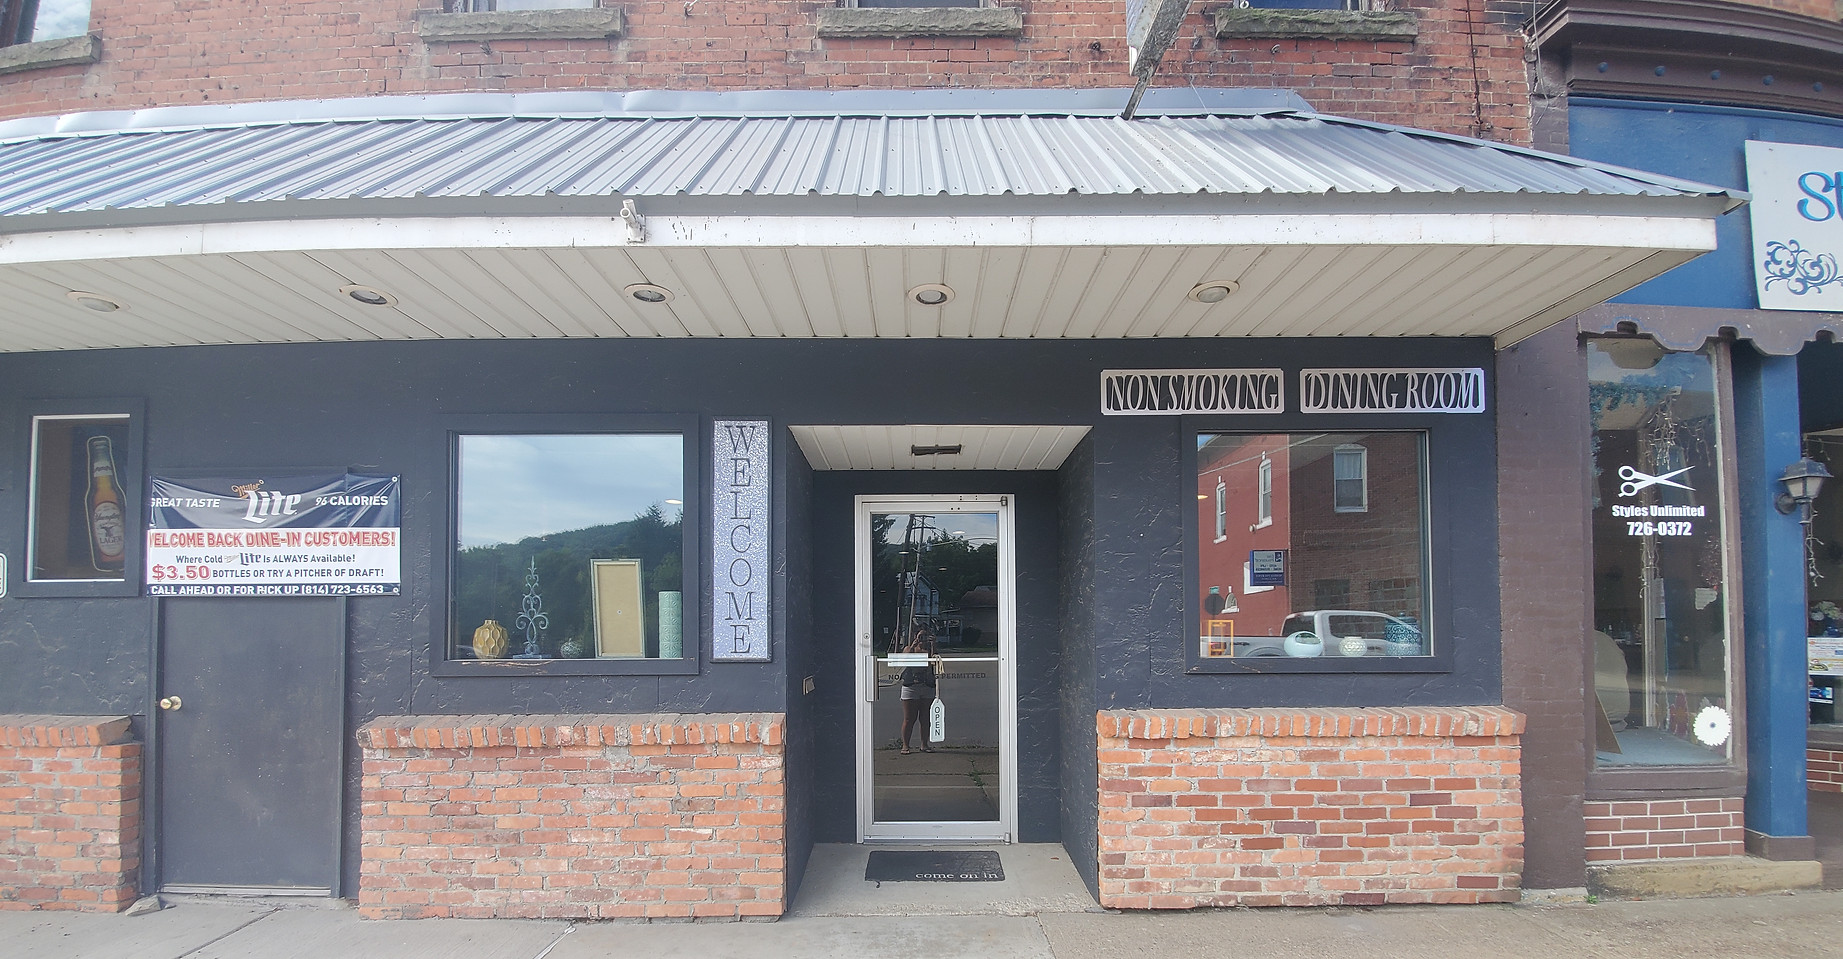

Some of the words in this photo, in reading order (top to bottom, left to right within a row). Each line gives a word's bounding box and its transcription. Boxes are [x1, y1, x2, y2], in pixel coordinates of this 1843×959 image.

[1109, 374, 1162, 411] NON
[1166, 373, 1278, 410] SMOKING
[1306, 372, 1399, 410] DINING
[1404, 372, 1477, 409] ROOM
[231, 479, 265, 500] Miller
[185, 498, 221, 508] TASTE
[241, 490, 302, 524] Lite
[315, 496, 328, 506] 96
[329, 495, 389, 506] CALORIES
[1611, 505, 1649, 518] Styles
[1649, 505, 1705, 517] Unlimited
[1626, 521, 1693, 536] 726-0372
[206, 532, 244, 547] BACK
[245, 532, 302, 547] DINE-IN
[304, 531, 396, 547] CUSTOMERS!
[724, 425, 756, 654] WELCOME
[175, 555, 203, 564] Where
[204, 555, 223, 564] Cold
[239, 552, 262, 566] Lite
[272, 554, 309, 563] ALWAYS
[310, 554, 356, 563] Available!
[151, 564, 211, 582] $3.50
[212, 569, 251, 578] BOTTLES
[253, 569, 266, 578] OR
[266, 569, 284, 578] TRY
[285, 569, 293, 577] A
[294, 569, 332, 577] PITCHER
[334, 569, 346, 577] OF
[348, 568, 385, 577] DRAFT!
[151, 585, 178, 595] CALL
[179, 585, 215, 595] AHEAD
[216, 585, 232, 595] OR
[233, 585, 255, 595] FOR
[256, 585, 279, 595] PICK
[284, 585, 300, 595] UP
[301, 584, 329, 595] (814)
[330, 584, 384, 594] 723-6563
[941, 672, 986, 680] PERMITTED
